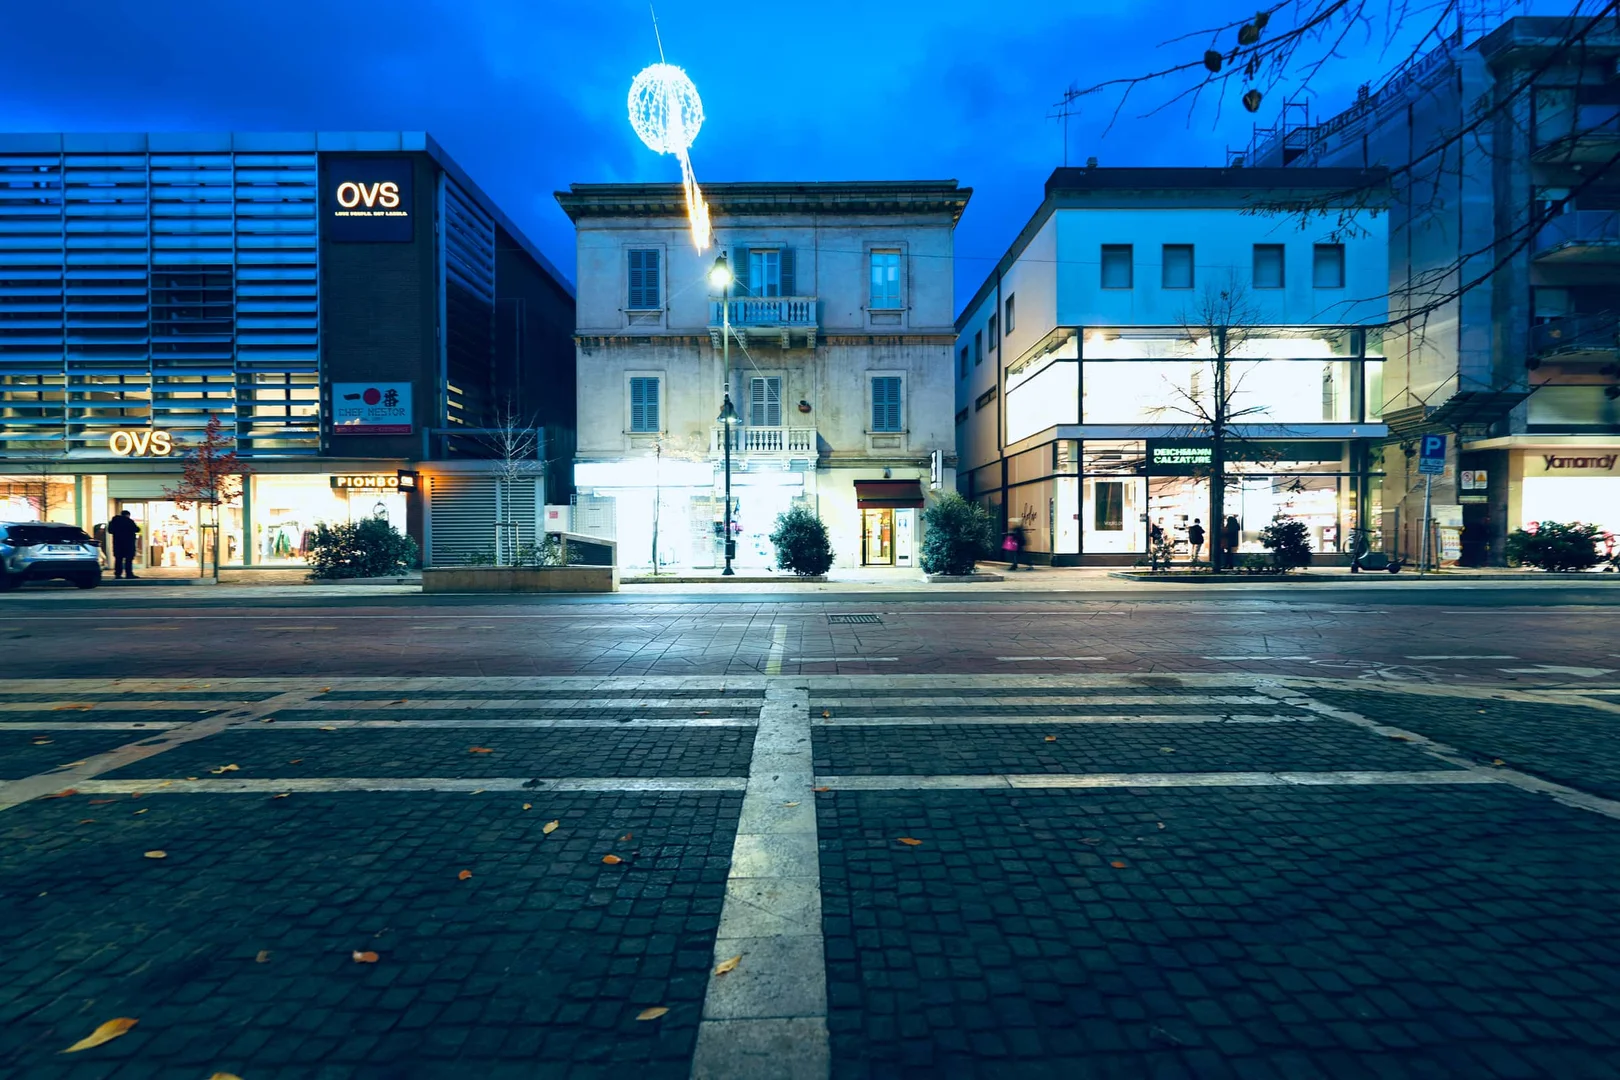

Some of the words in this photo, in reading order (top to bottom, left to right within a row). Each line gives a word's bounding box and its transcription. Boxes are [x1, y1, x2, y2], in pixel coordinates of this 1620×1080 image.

[337, 181, 400, 208] OVS
[338, 408, 363, 417] CHEF
[368, 408, 406, 417] NESTOR
[109, 430, 172, 456] OVS
[1425, 436, 1441, 456] P
[1153, 448, 1212, 456] DEICHMANN
[1153, 456, 1212, 464] CALZATURE
[337, 477, 399, 487] PIOMBO
